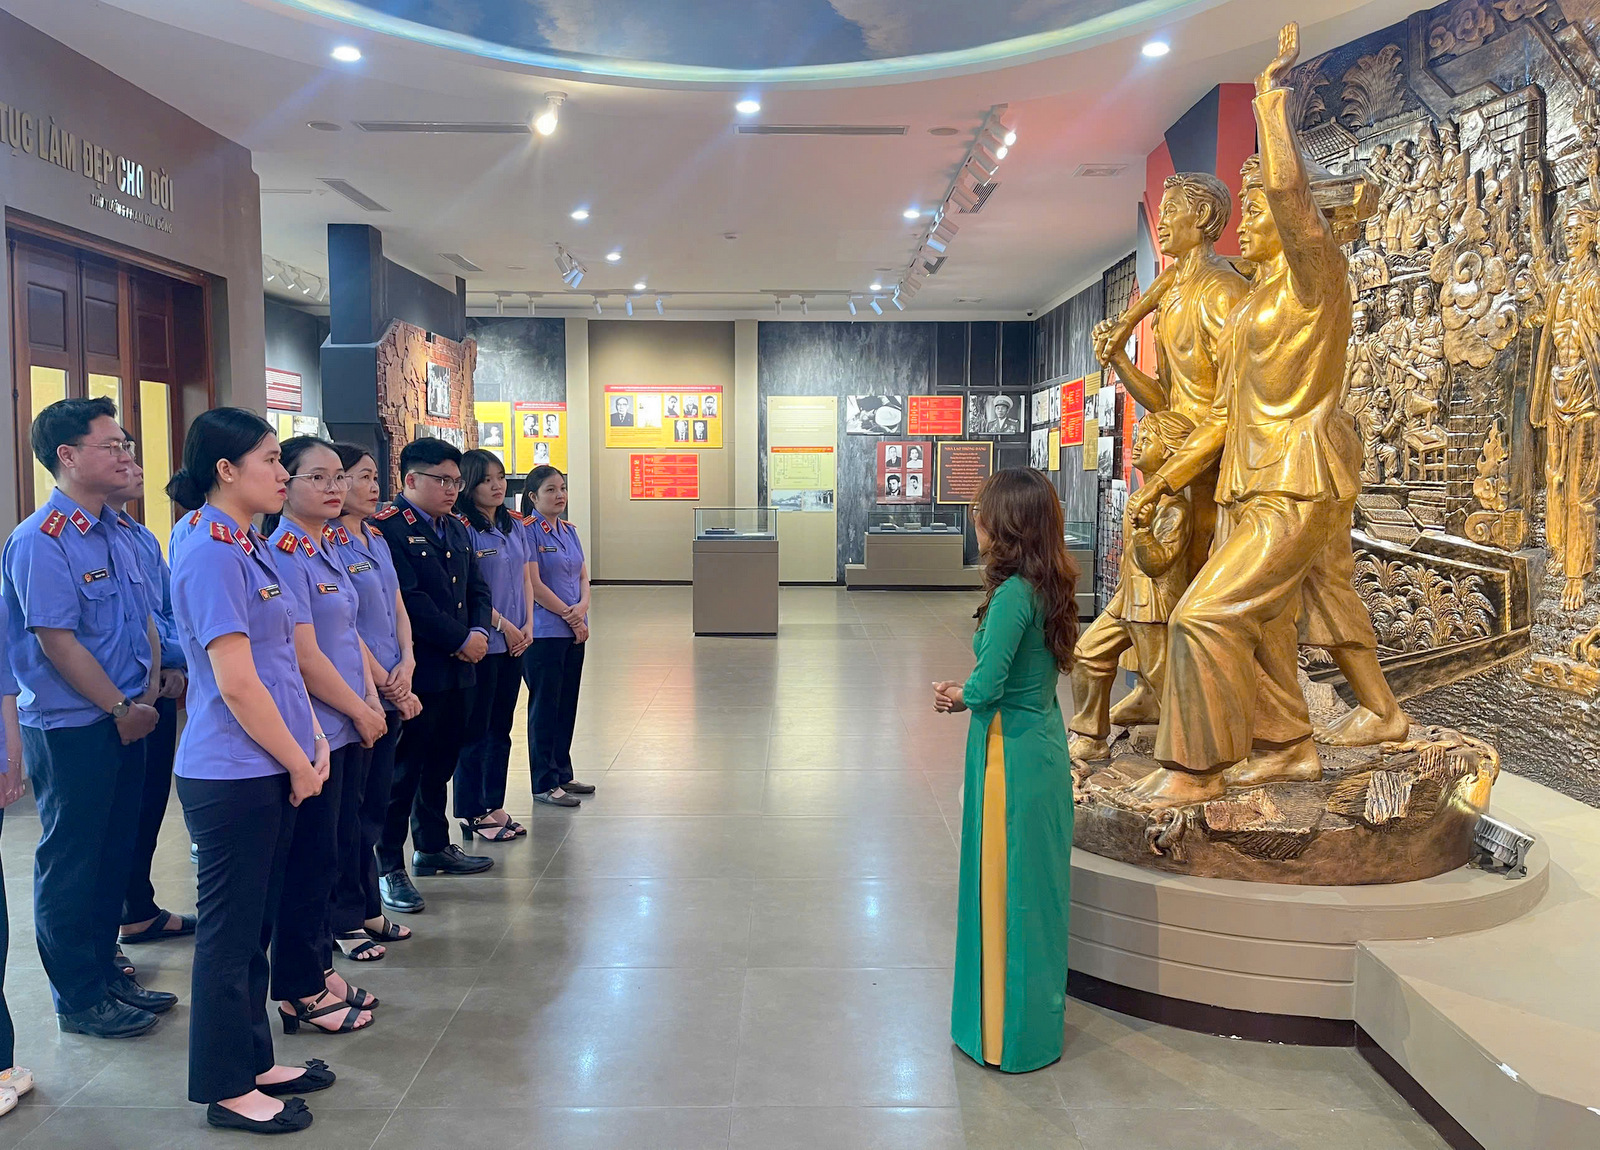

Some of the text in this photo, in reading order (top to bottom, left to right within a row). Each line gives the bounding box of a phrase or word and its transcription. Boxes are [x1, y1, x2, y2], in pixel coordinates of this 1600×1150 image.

[38, 116, 77, 172] LÀM
[82, 138, 114, 188] ĐẸP
[116, 155, 145, 199] CHO
[150, 167, 174, 212] ĐỜI
